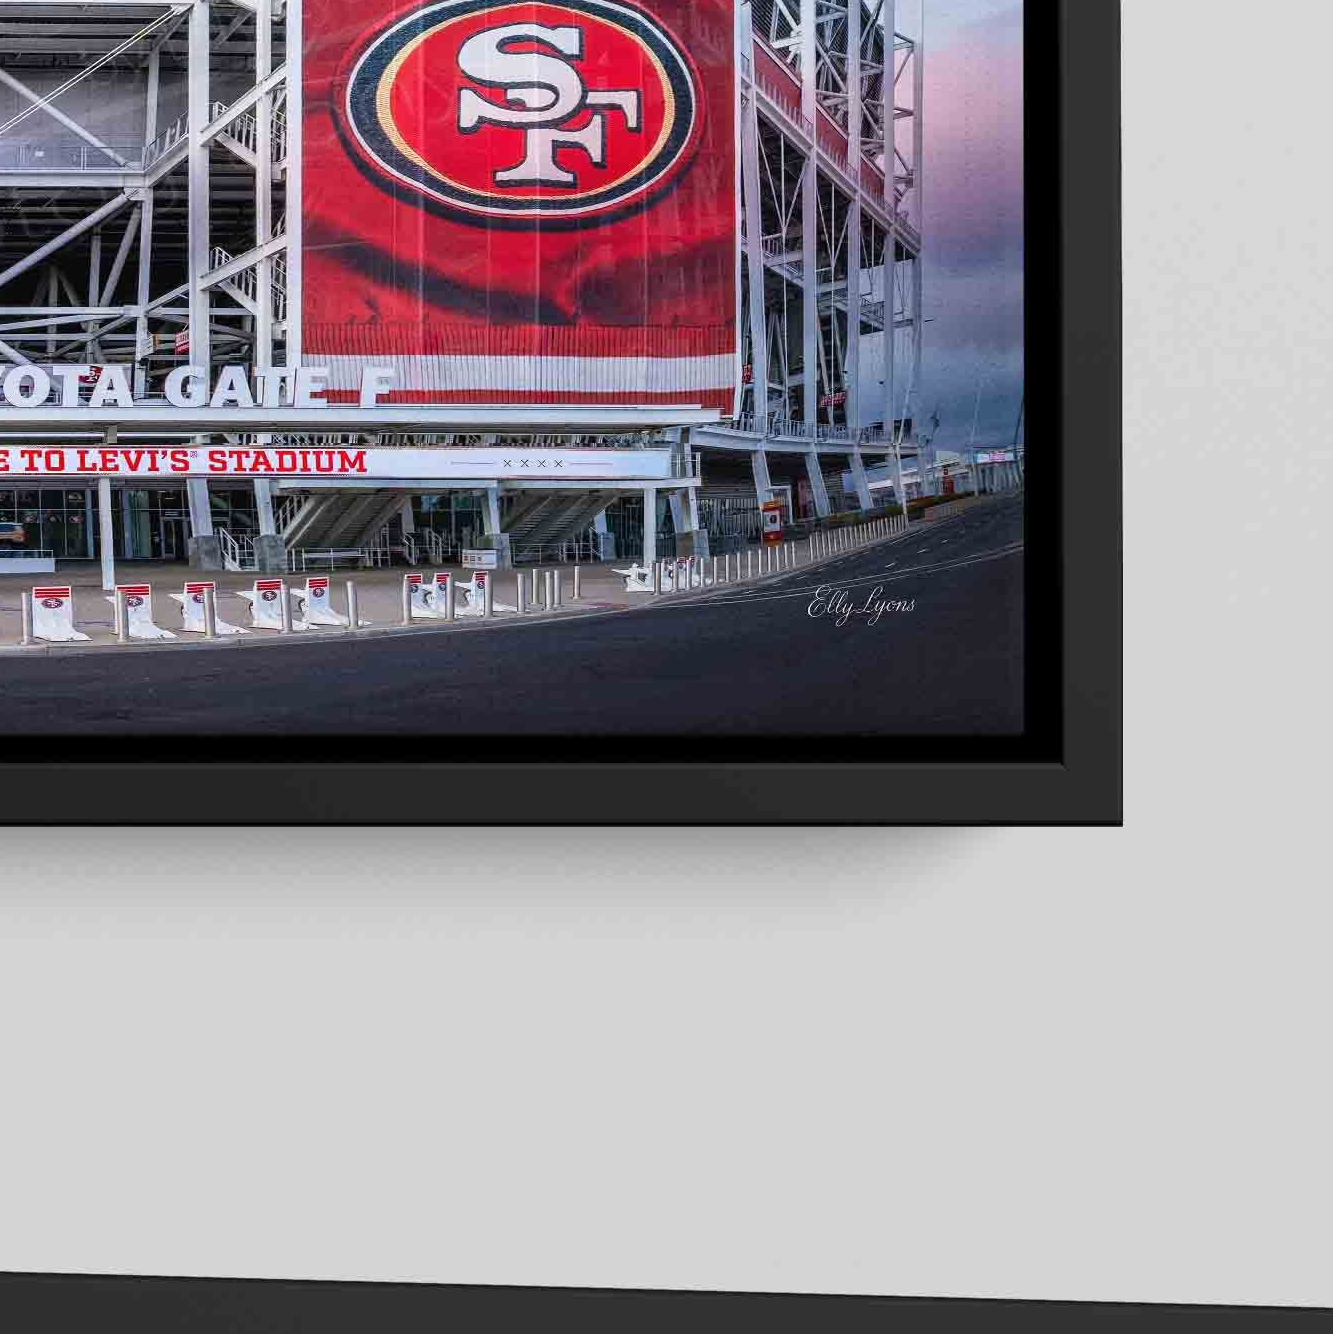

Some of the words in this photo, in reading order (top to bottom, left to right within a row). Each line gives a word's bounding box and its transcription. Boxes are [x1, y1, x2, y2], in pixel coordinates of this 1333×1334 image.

[164, 364, 330, 408] GATE
[359, 366, 395, 408] F
[20, 450, 66, 472] TO
[208, 450, 368, 473] STADIUM
